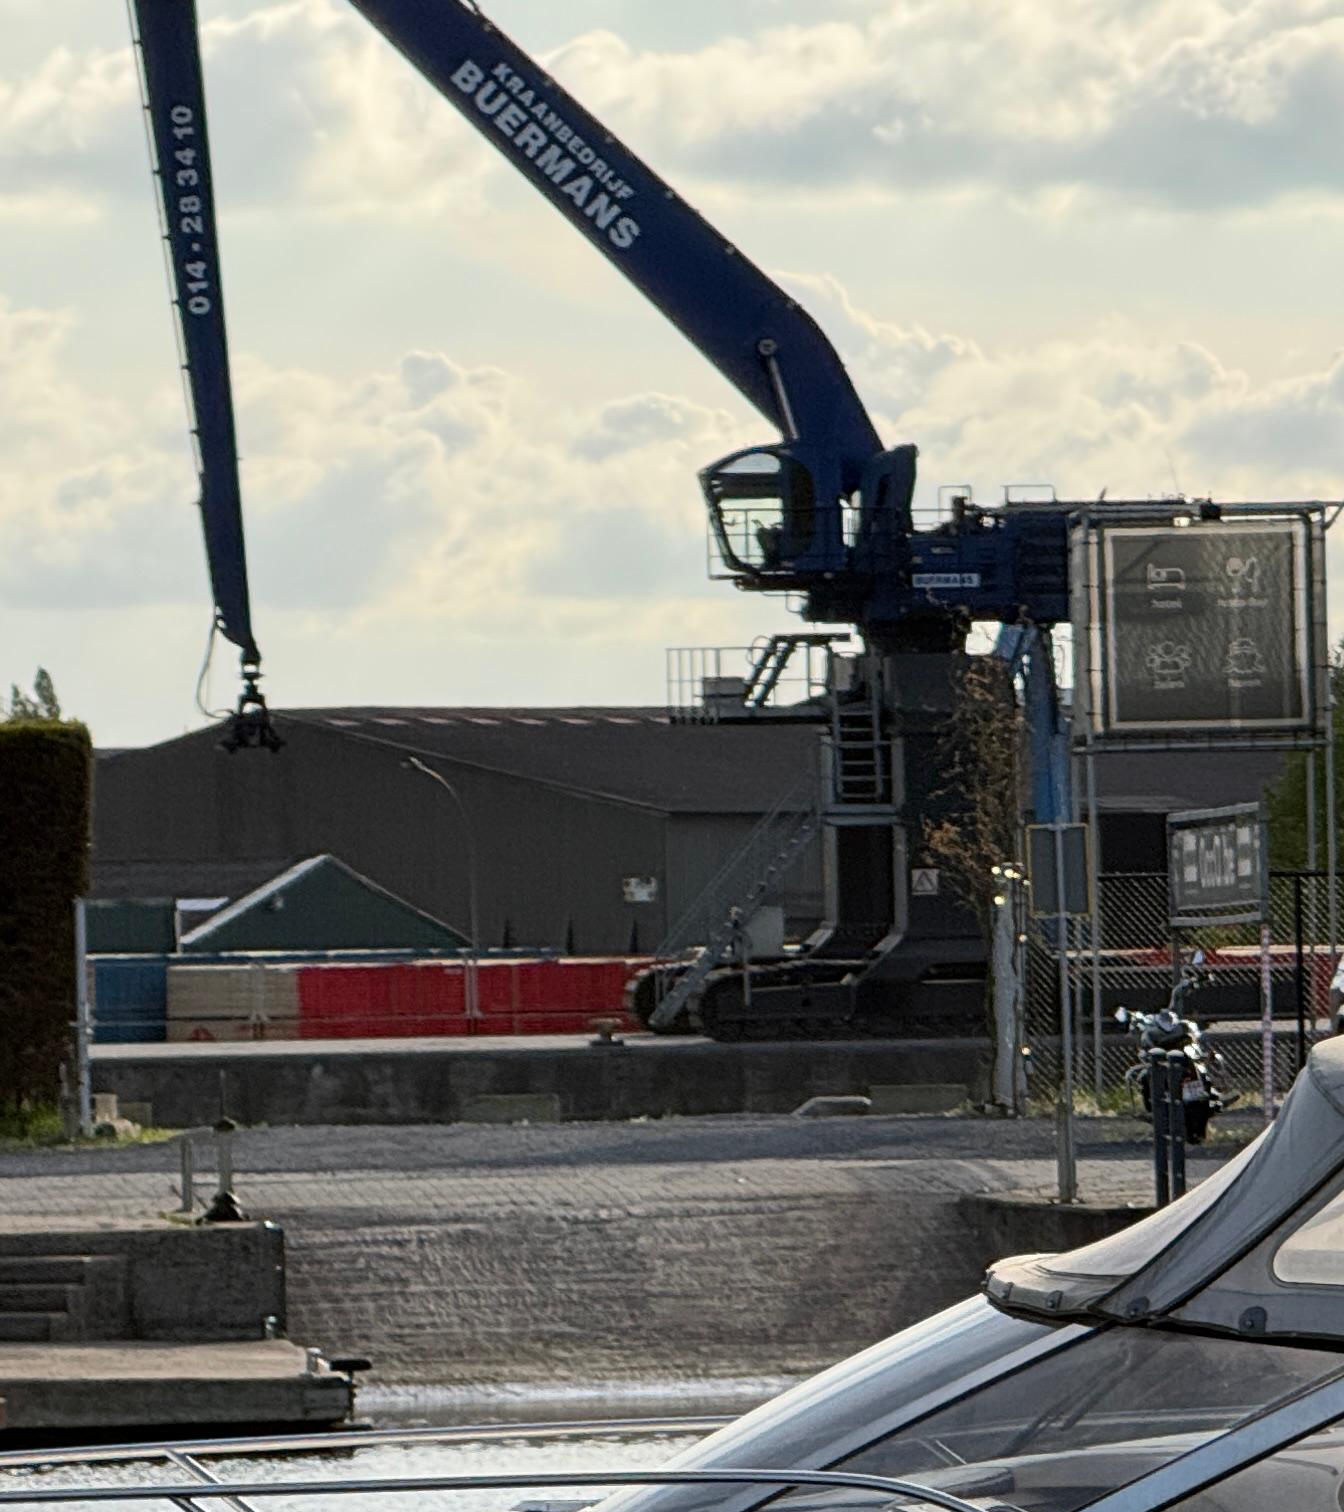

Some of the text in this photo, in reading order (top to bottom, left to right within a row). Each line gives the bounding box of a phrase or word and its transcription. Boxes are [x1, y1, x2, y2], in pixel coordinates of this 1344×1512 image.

[170, 105, 195, 140] 10
[491, 63, 635, 200] KRAANBEDRIJF
[174, 147, 199, 187] 34
[450, 59, 641, 248] BUERMANS
[179, 195, 204, 234] 28
[185, 260, 211, 315] 014
